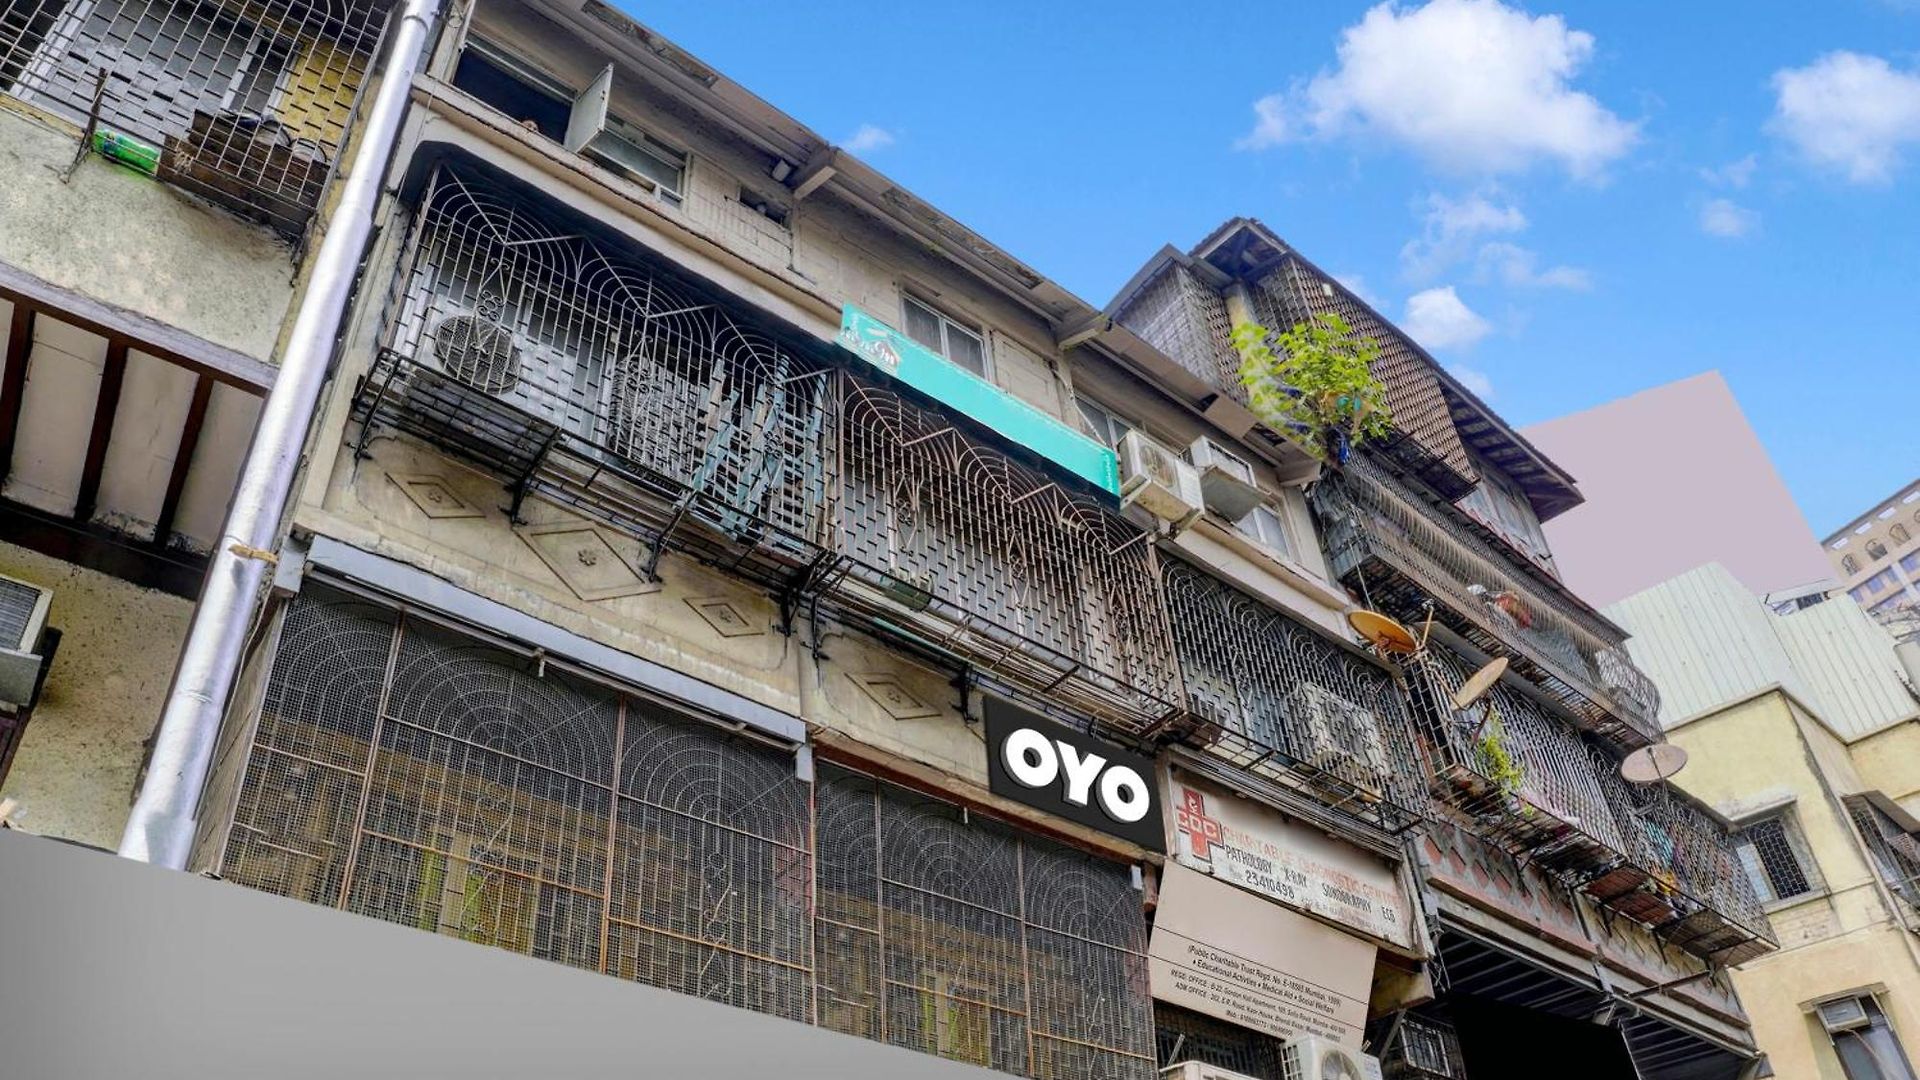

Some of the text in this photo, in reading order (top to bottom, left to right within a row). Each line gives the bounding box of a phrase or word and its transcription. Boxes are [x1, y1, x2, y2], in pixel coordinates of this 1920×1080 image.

[1000, 728, 1150, 823] OYO
[1225, 844, 1272, 874] PATHOLOGY
[1283, 866, 1307, 888] X-RAY
[1321, 882, 1371, 913] SONOGRAPHY
[1381, 905, 1396, 923] ECG
[1198, 959, 1232, 977] Educational
[1232, 972, 1256, 987] Activities
[1262, 982, 1283, 996] Medical
[1284, 990, 1293, 1000] Aid
[1298, 995, 1315, 1007] Social
